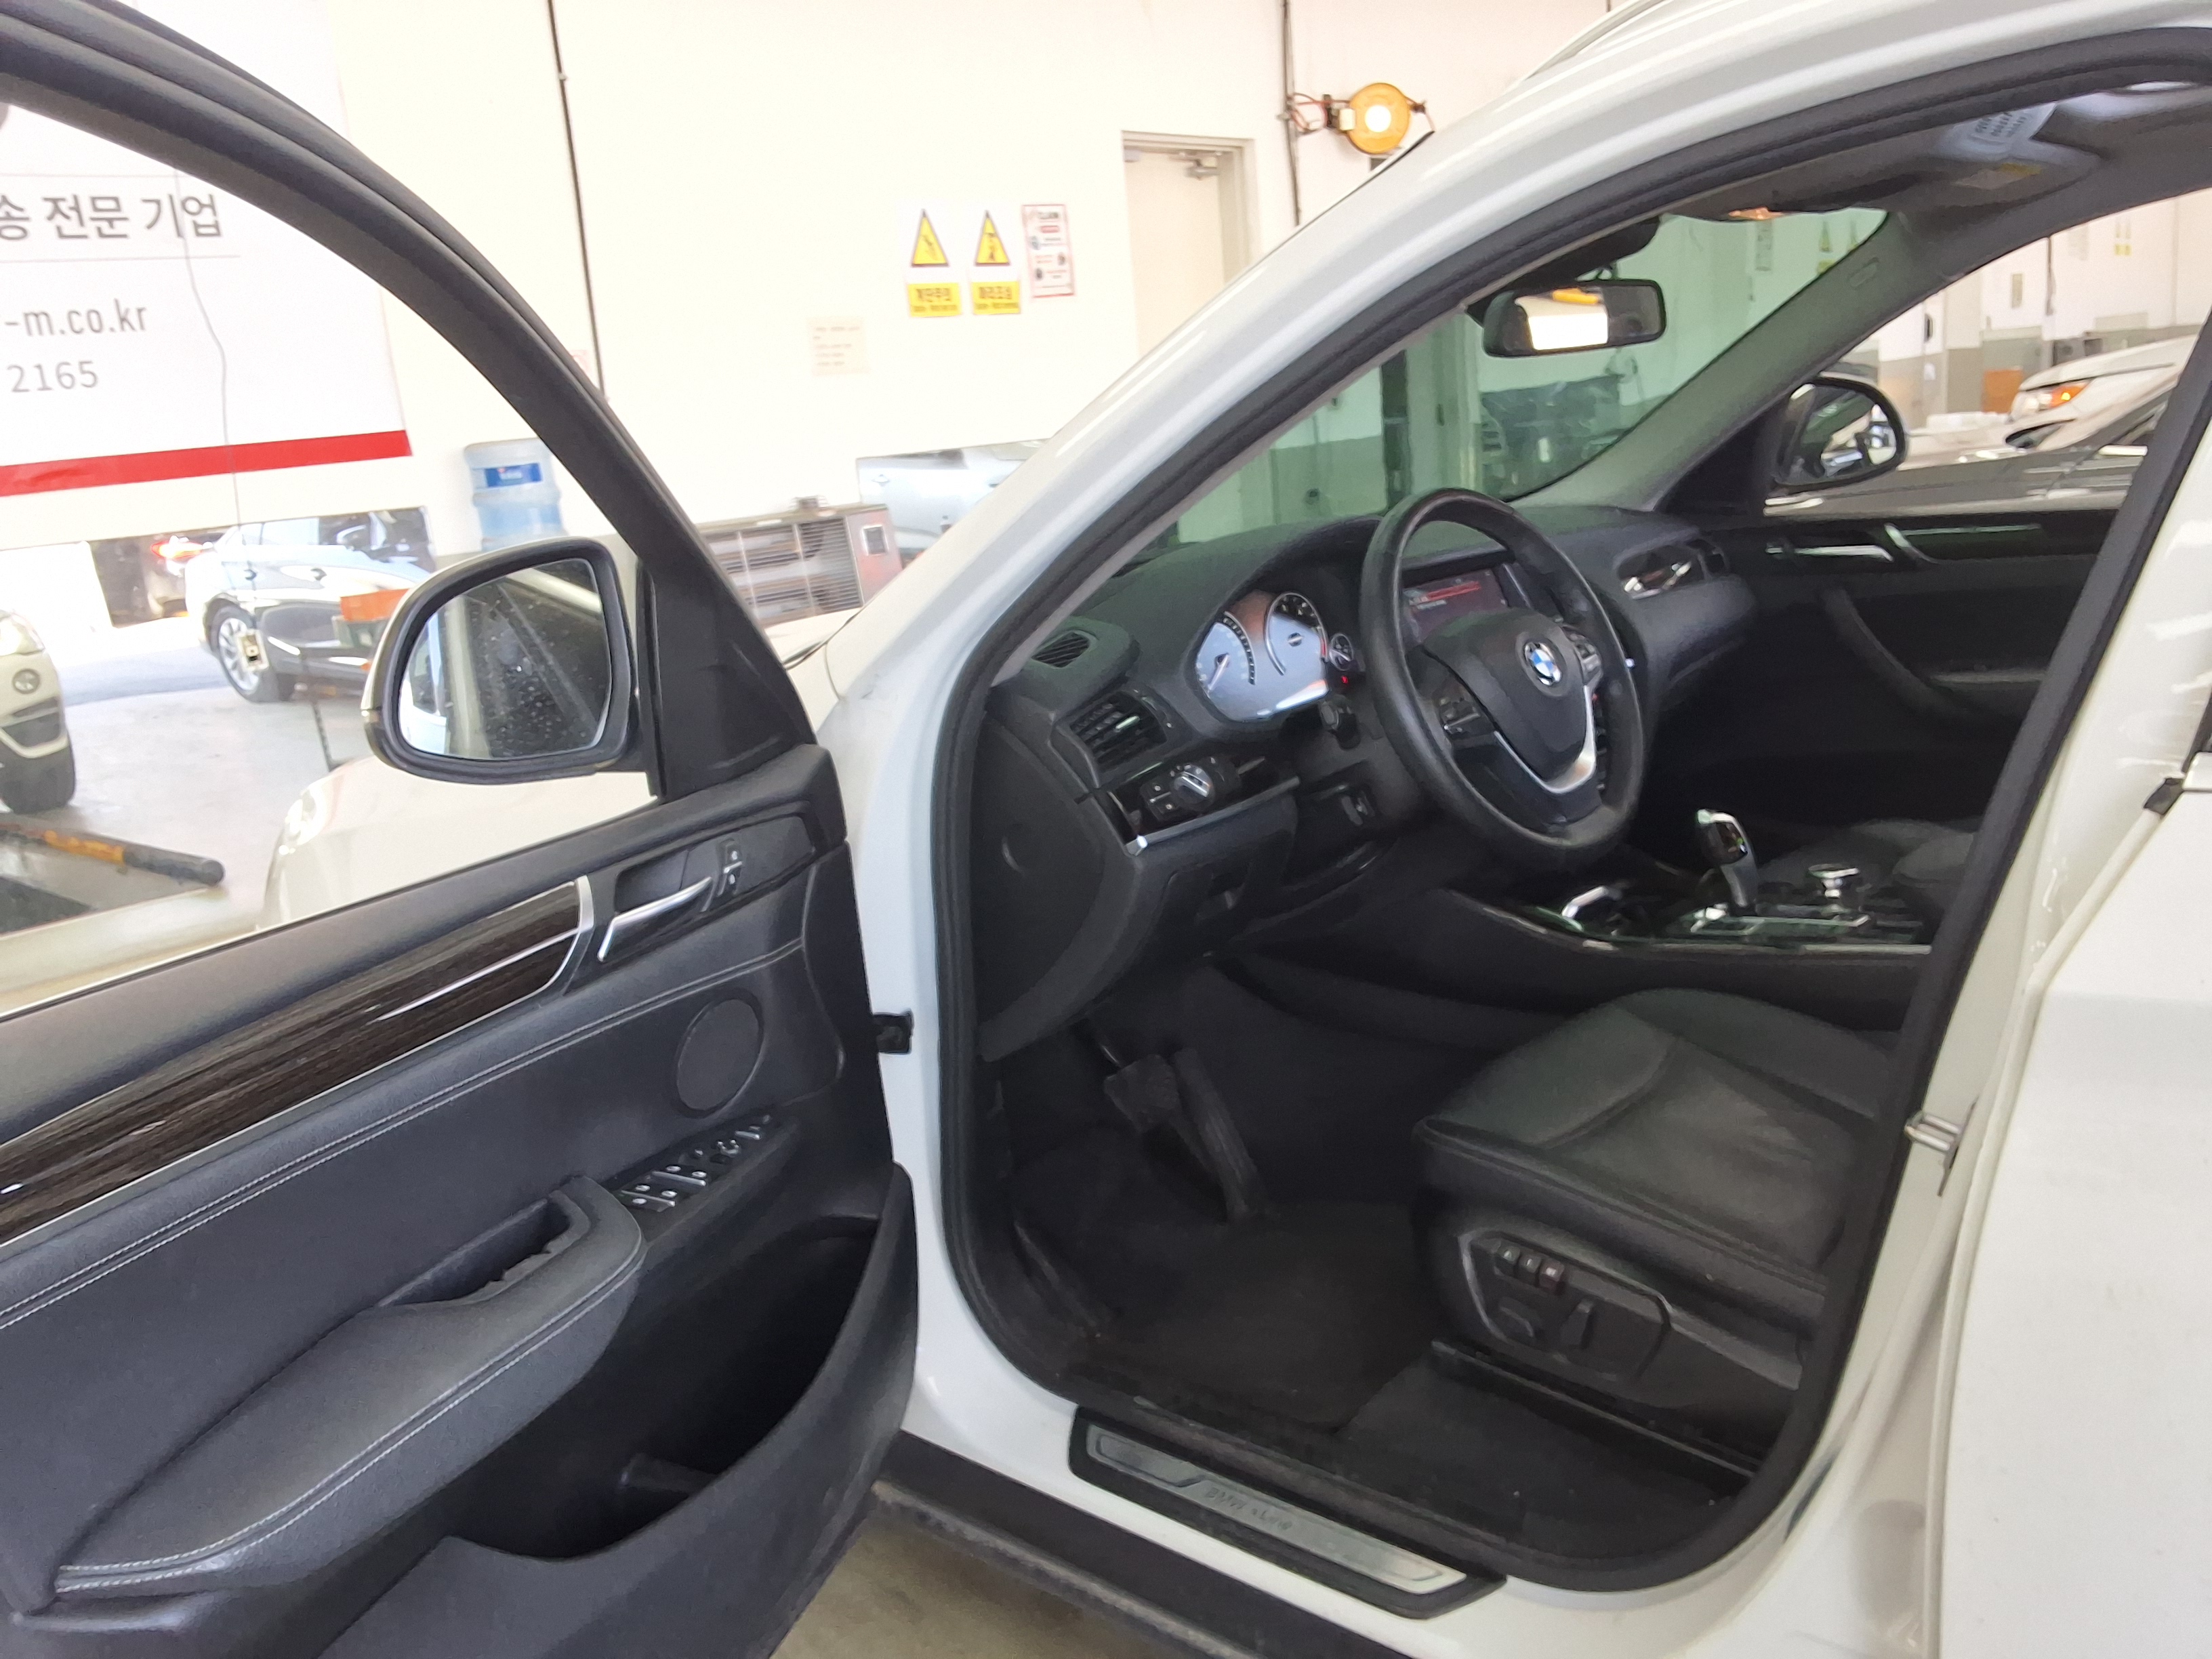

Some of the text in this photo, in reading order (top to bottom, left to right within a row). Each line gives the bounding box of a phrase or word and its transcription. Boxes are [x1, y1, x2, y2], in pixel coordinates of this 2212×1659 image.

[0, 193, 222, 241] 송 전문 기업
[4, 298, 147, 337] -m.co.kr
[7, 361, 98, 393] 2165
